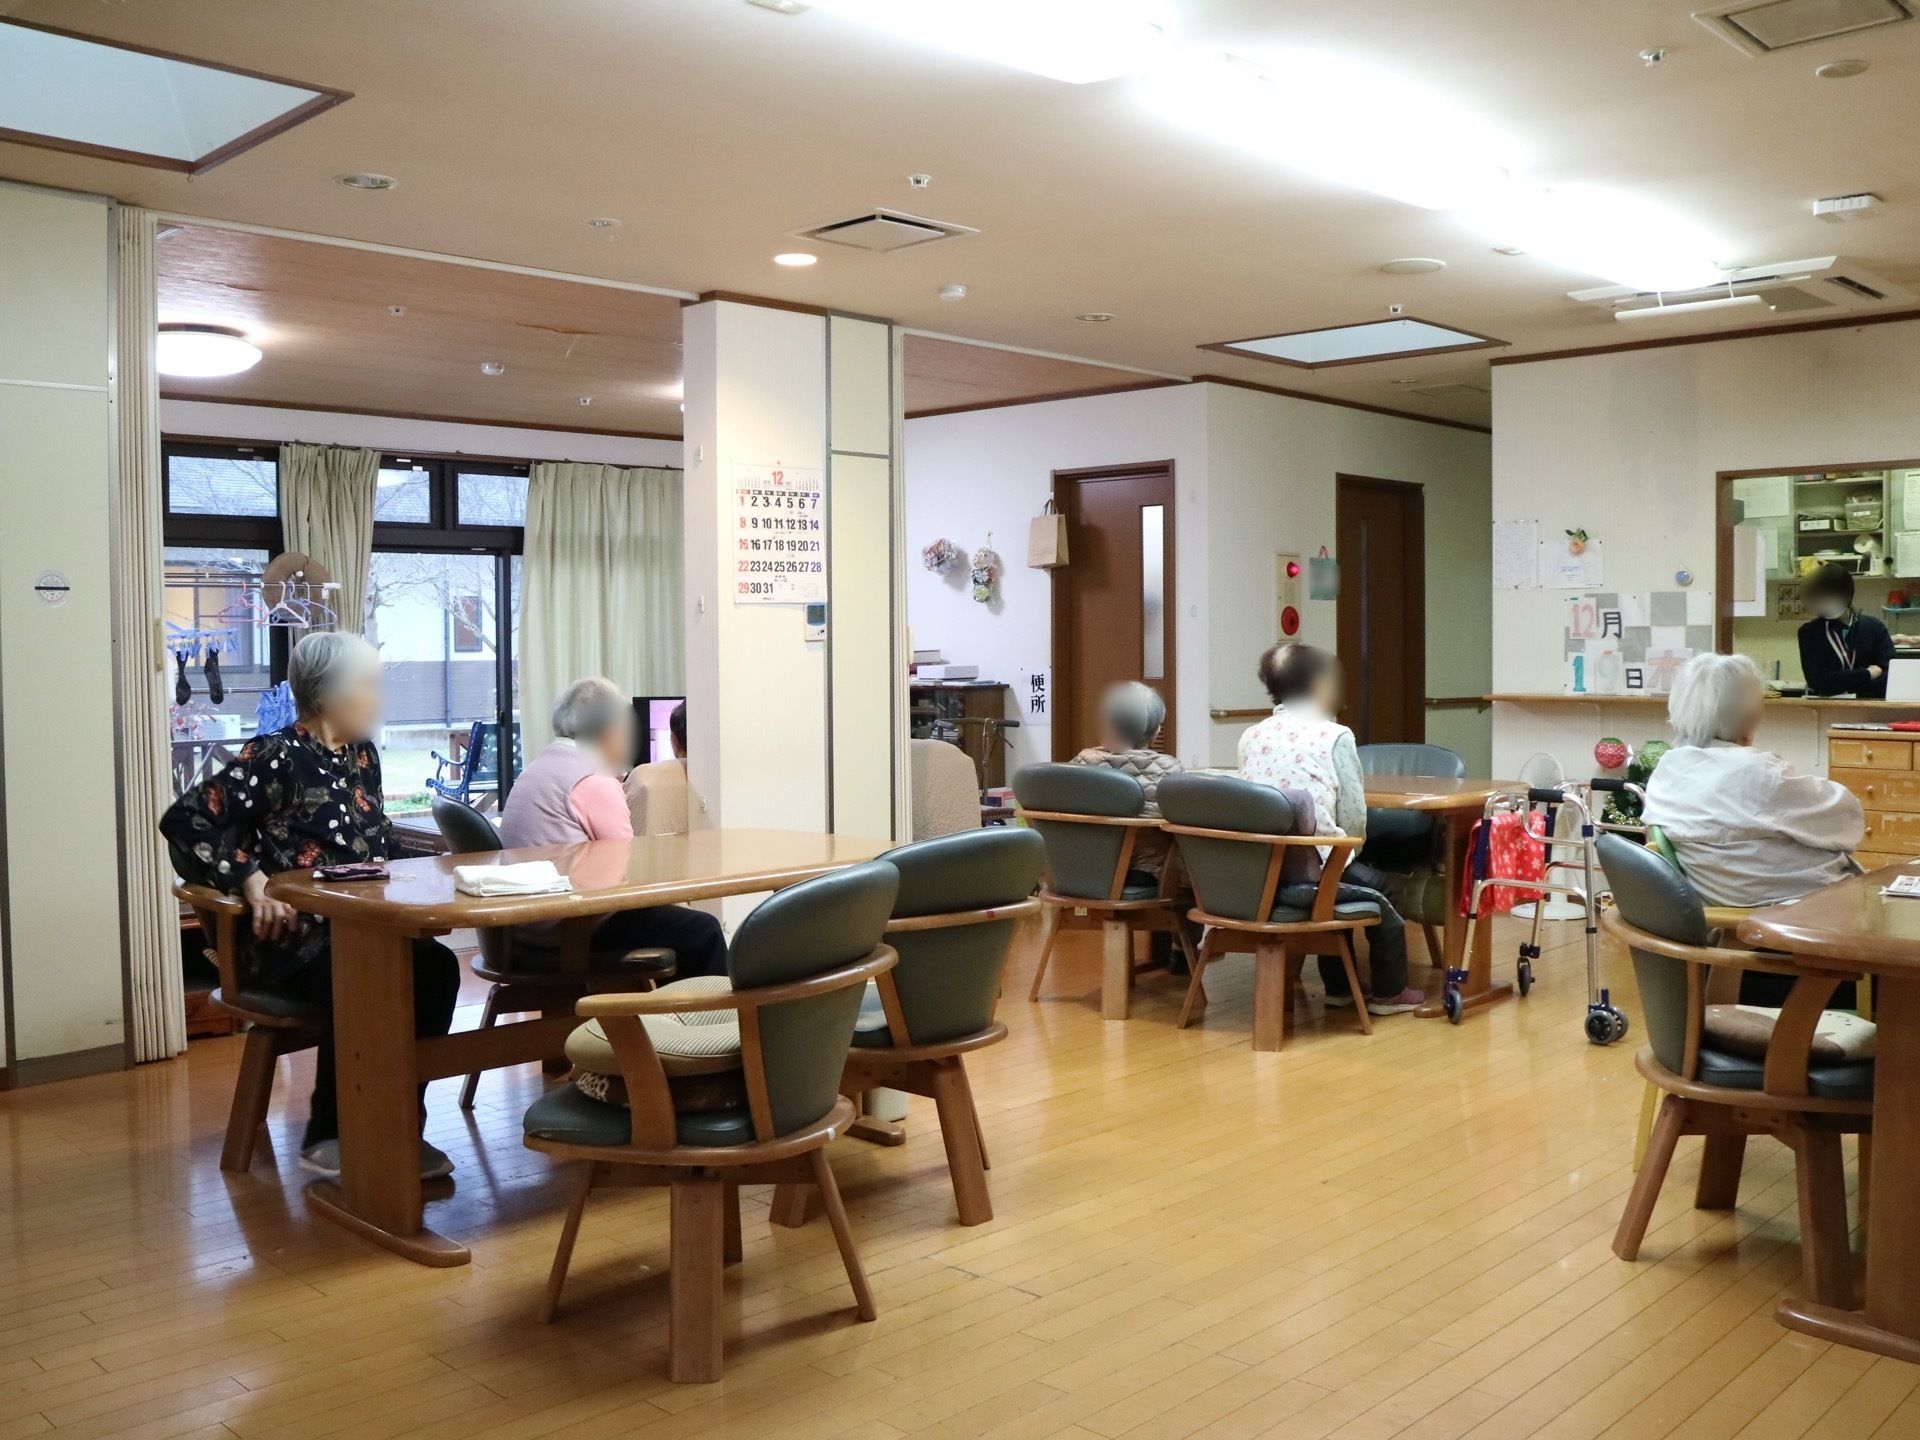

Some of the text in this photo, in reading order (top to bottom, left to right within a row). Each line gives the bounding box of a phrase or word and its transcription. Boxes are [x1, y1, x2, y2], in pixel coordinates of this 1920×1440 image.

[772, 471, 783, 485] 12
[740, 496, 816, 509] 1 2 3 4 5 6 7
[740, 517, 818, 530] 8 9 10 11 12 13 14
[739, 539, 819, 551] 15 16 17 18 19 20 21
[738, 561, 821, 572] 22 23 24 25 26 27 28
[739, 582, 749, 593] 29
[751, 583, 761, 593] 30
[763, 583, 773, 593] 31
[1572, 603, 1622, 639] 12月
[1031, 673, 1045, 713] 便所
